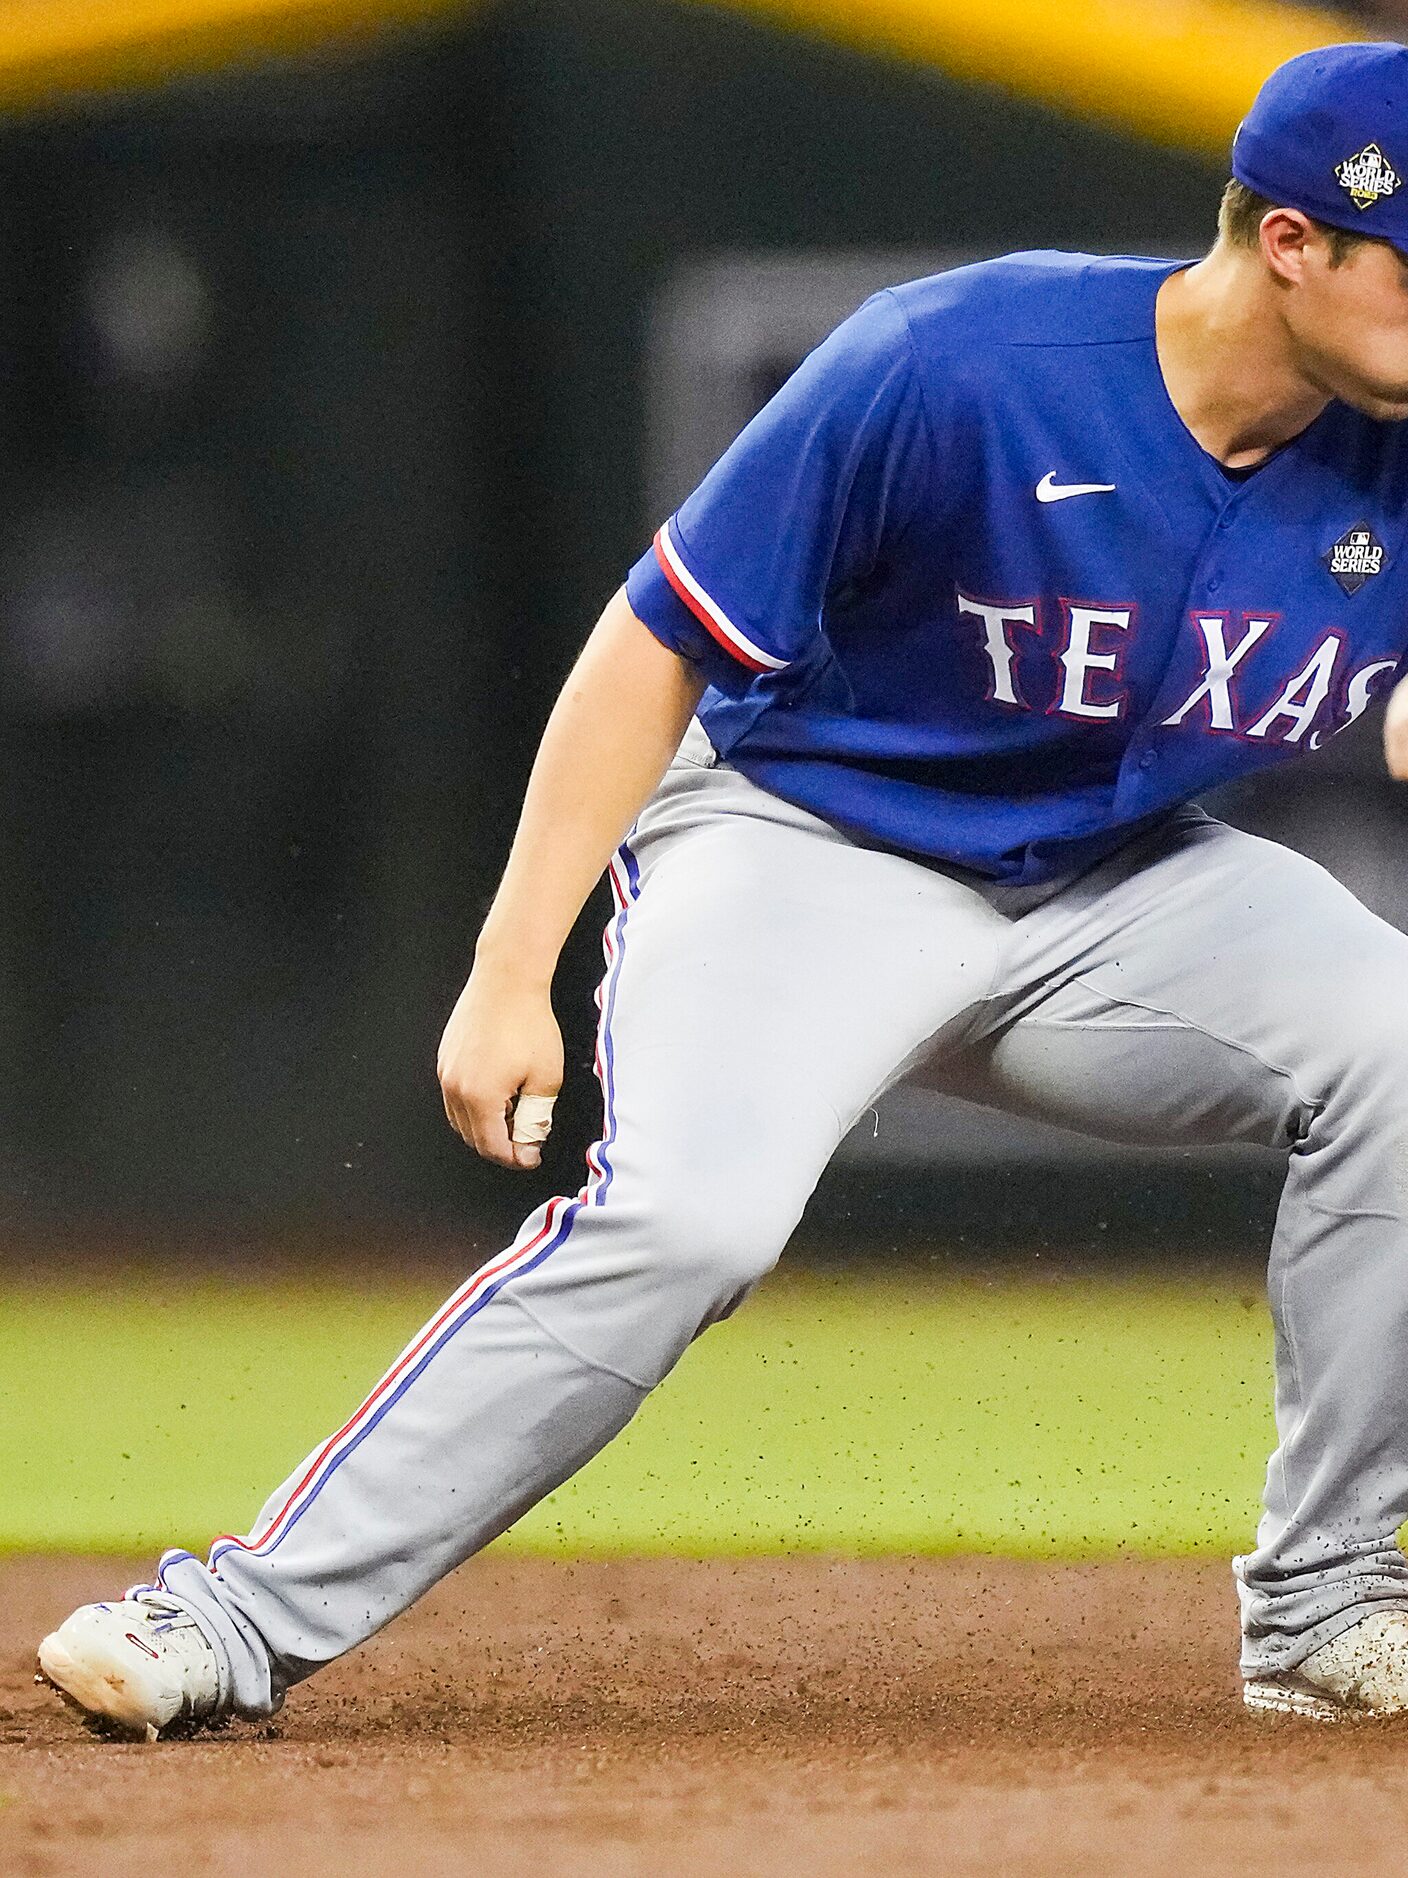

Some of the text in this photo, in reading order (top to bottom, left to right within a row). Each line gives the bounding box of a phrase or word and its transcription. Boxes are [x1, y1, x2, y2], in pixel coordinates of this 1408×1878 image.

[1343, 161, 1396, 183] WORLD
[1340, 174, 1394, 195] SERIES
[1334, 545, 1383, 560] WORLD
[1331, 558, 1381, 574] SERIES
[956, 592, 1400, 753] TEXAS
